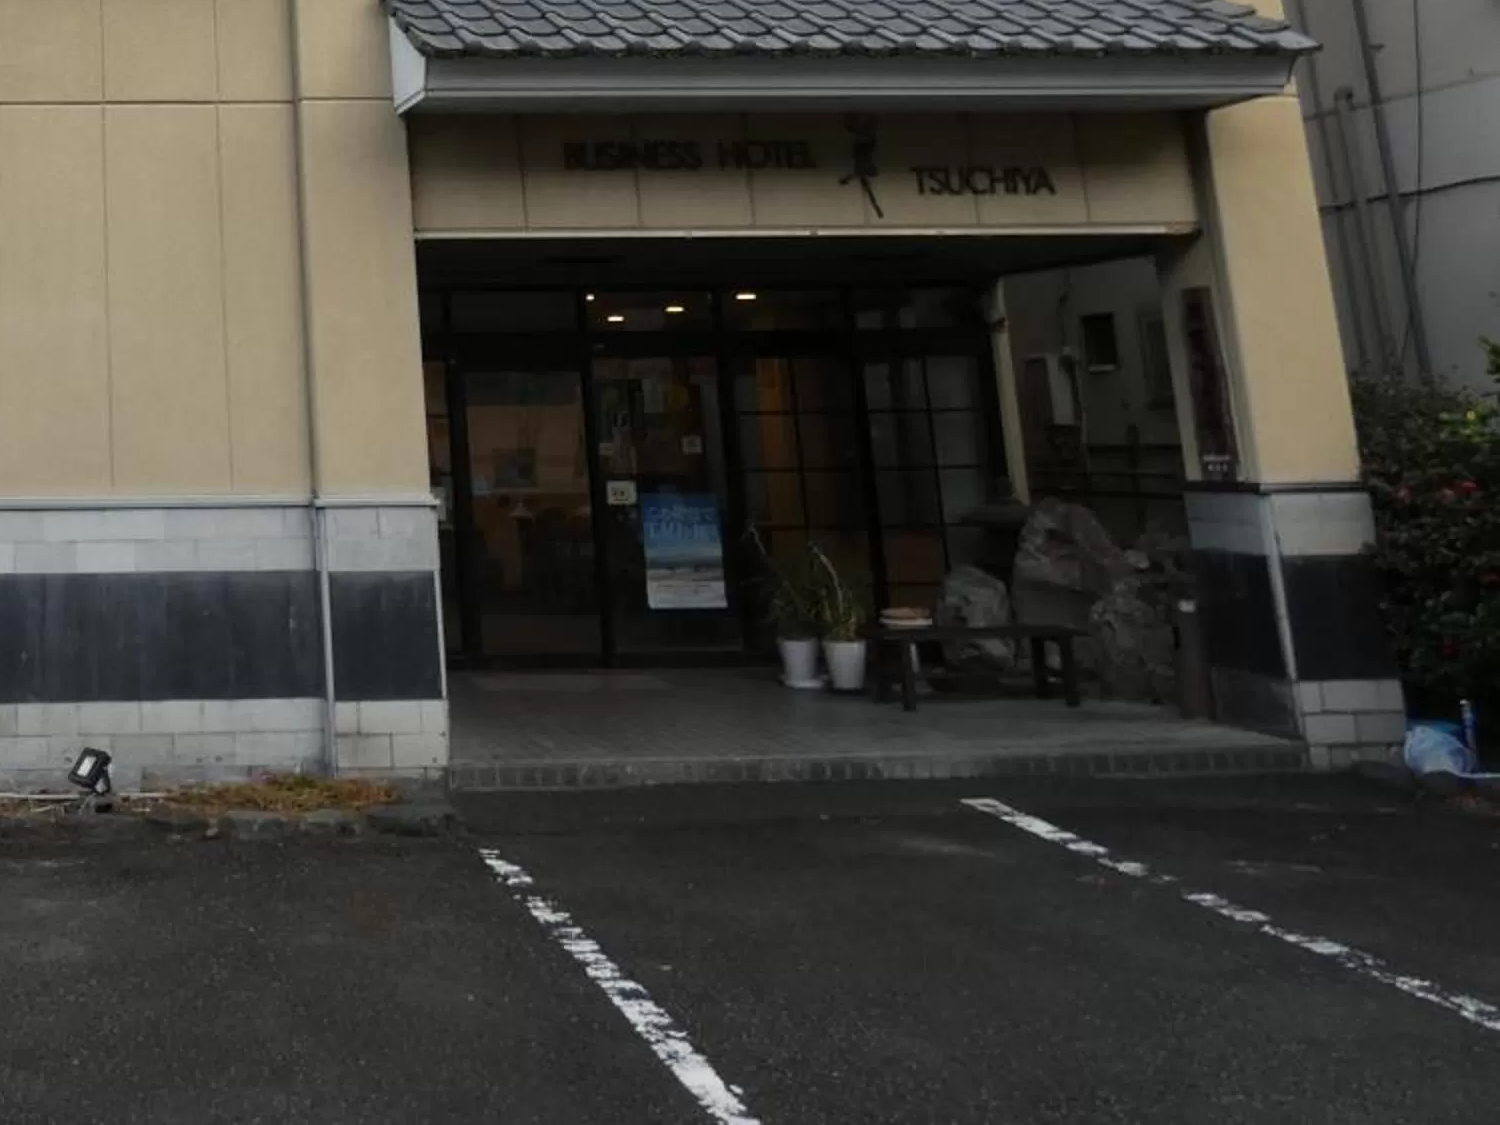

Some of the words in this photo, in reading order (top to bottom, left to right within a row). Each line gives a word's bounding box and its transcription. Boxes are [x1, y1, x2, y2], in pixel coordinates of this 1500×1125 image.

[563, 140, 704, 171] BUSINESS
[717, 139, 817, 171] HOTEL
[911, 166, 1057, 195] TSUCHIYA
